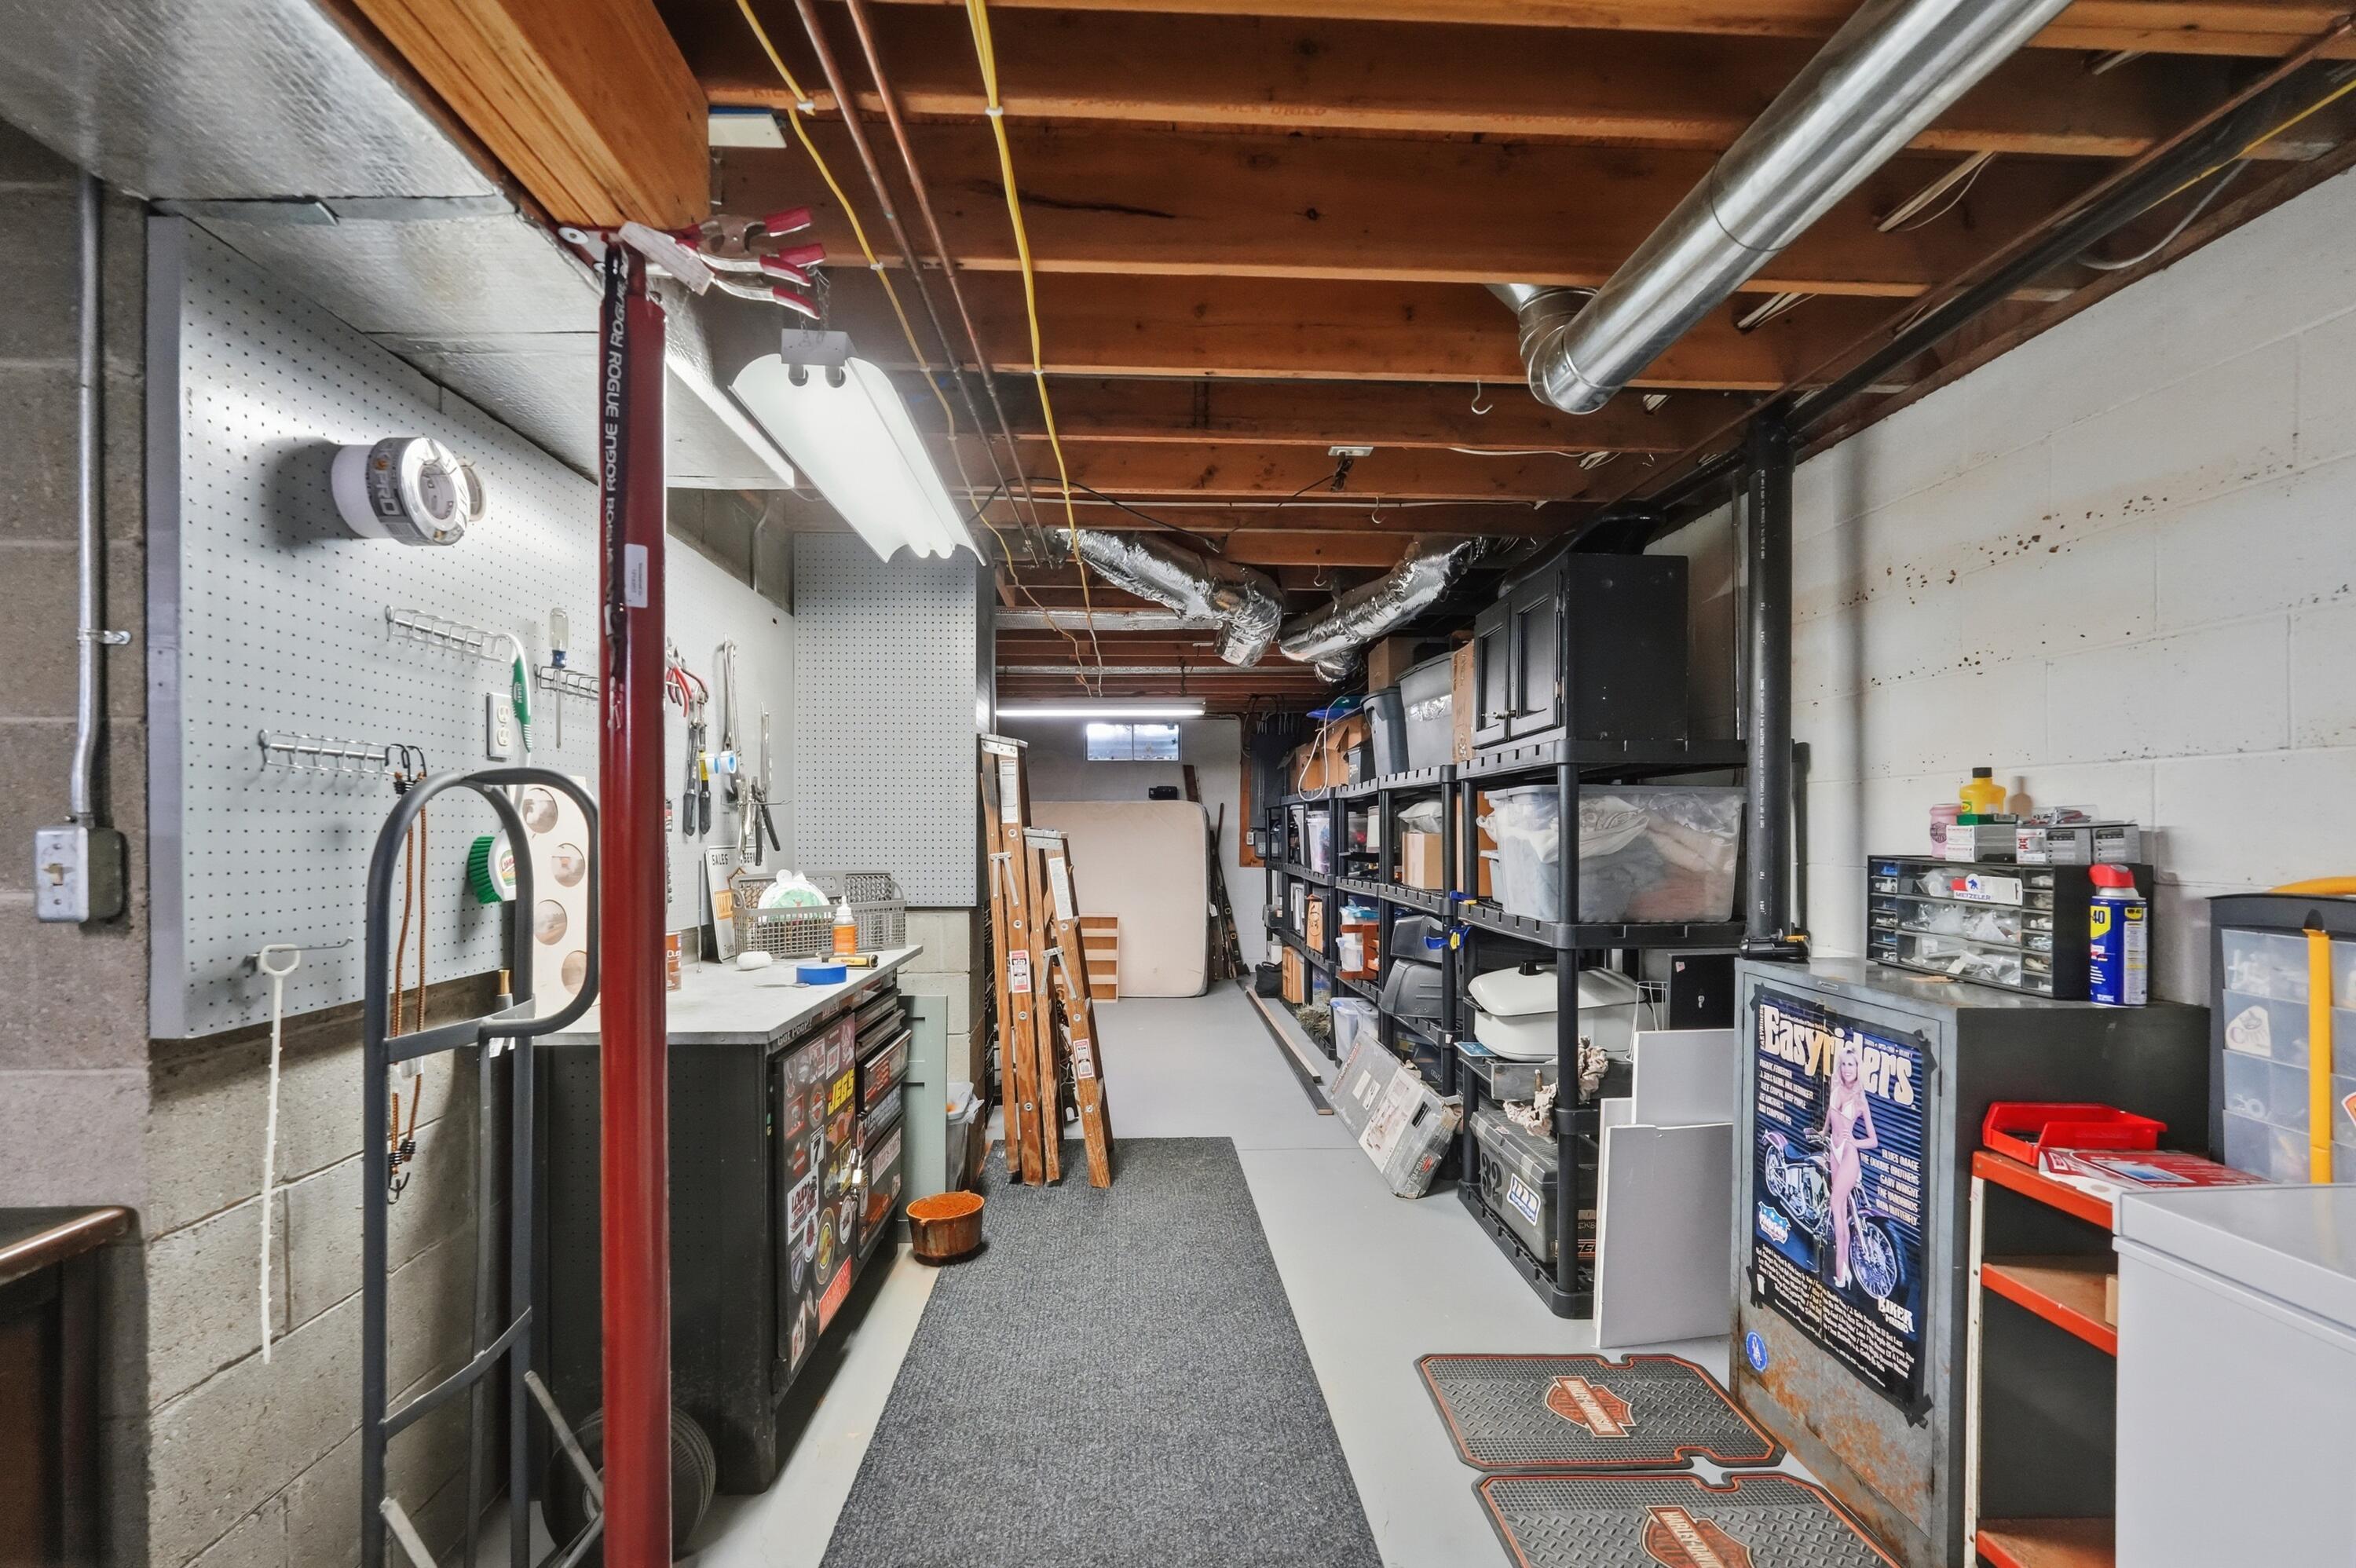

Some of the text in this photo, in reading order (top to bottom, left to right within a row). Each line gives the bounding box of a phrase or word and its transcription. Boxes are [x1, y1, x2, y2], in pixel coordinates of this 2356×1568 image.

[605, 351, 622, 417] ROGUE
[605, 422, 619, 492] ROGUE
[712, 853, 729, 865] SALES
[1955, 891, 1992, 901] METZELER
[1764, 1004, 1915, 1107] Easyriders
[827, 1068, 854, 1116] JEGS
[814, 1136, 821, 1168] 7
[1481, 1153, 1504, 1211] 32
[1878, 1296, 1915, 1332] BIKER
